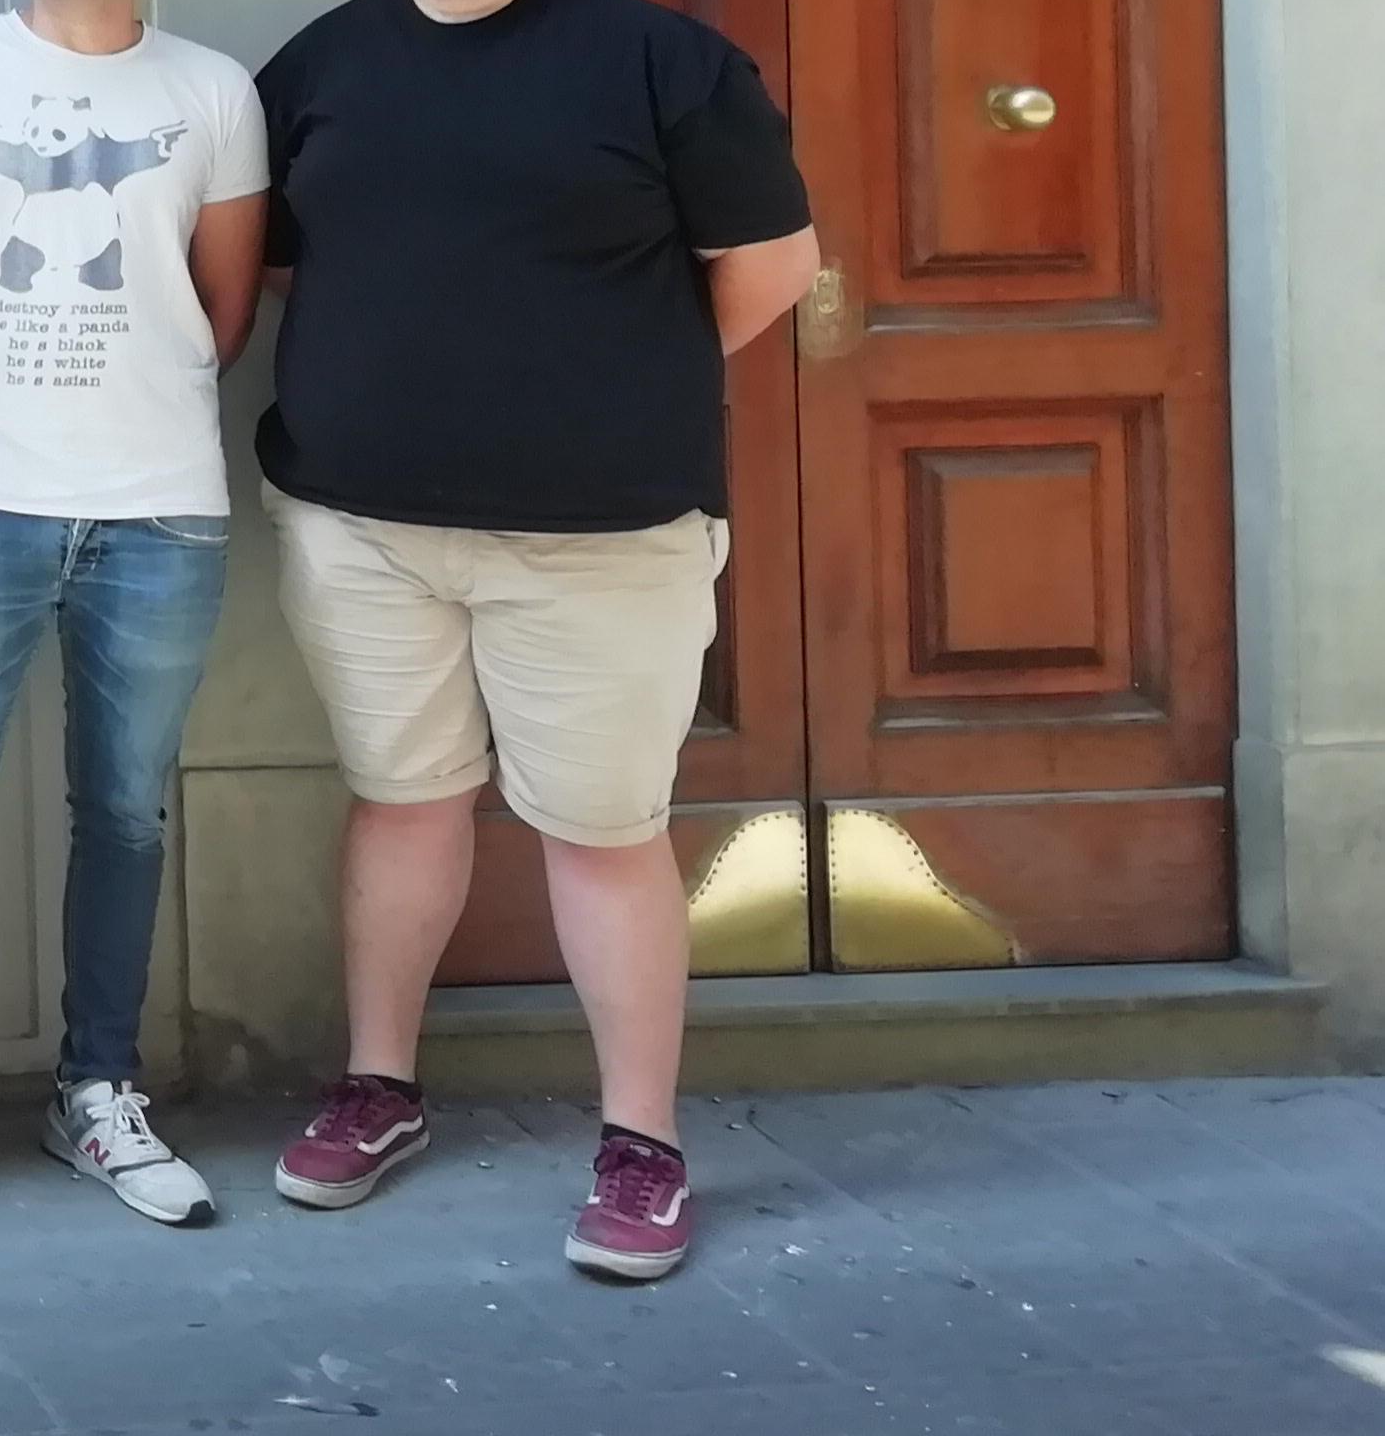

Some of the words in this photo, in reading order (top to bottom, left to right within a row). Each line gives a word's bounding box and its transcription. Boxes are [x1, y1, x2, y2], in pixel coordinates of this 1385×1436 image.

[70, 302, 128, 315] racism
[15, 319, 49, 333] like
[58, 323, 67, 333] a
[78, 320, 129, 335] panda
[58, 338, 107, 351] black
[55, 357, 106, 369] white
[53, 375, 101, 387] asian
